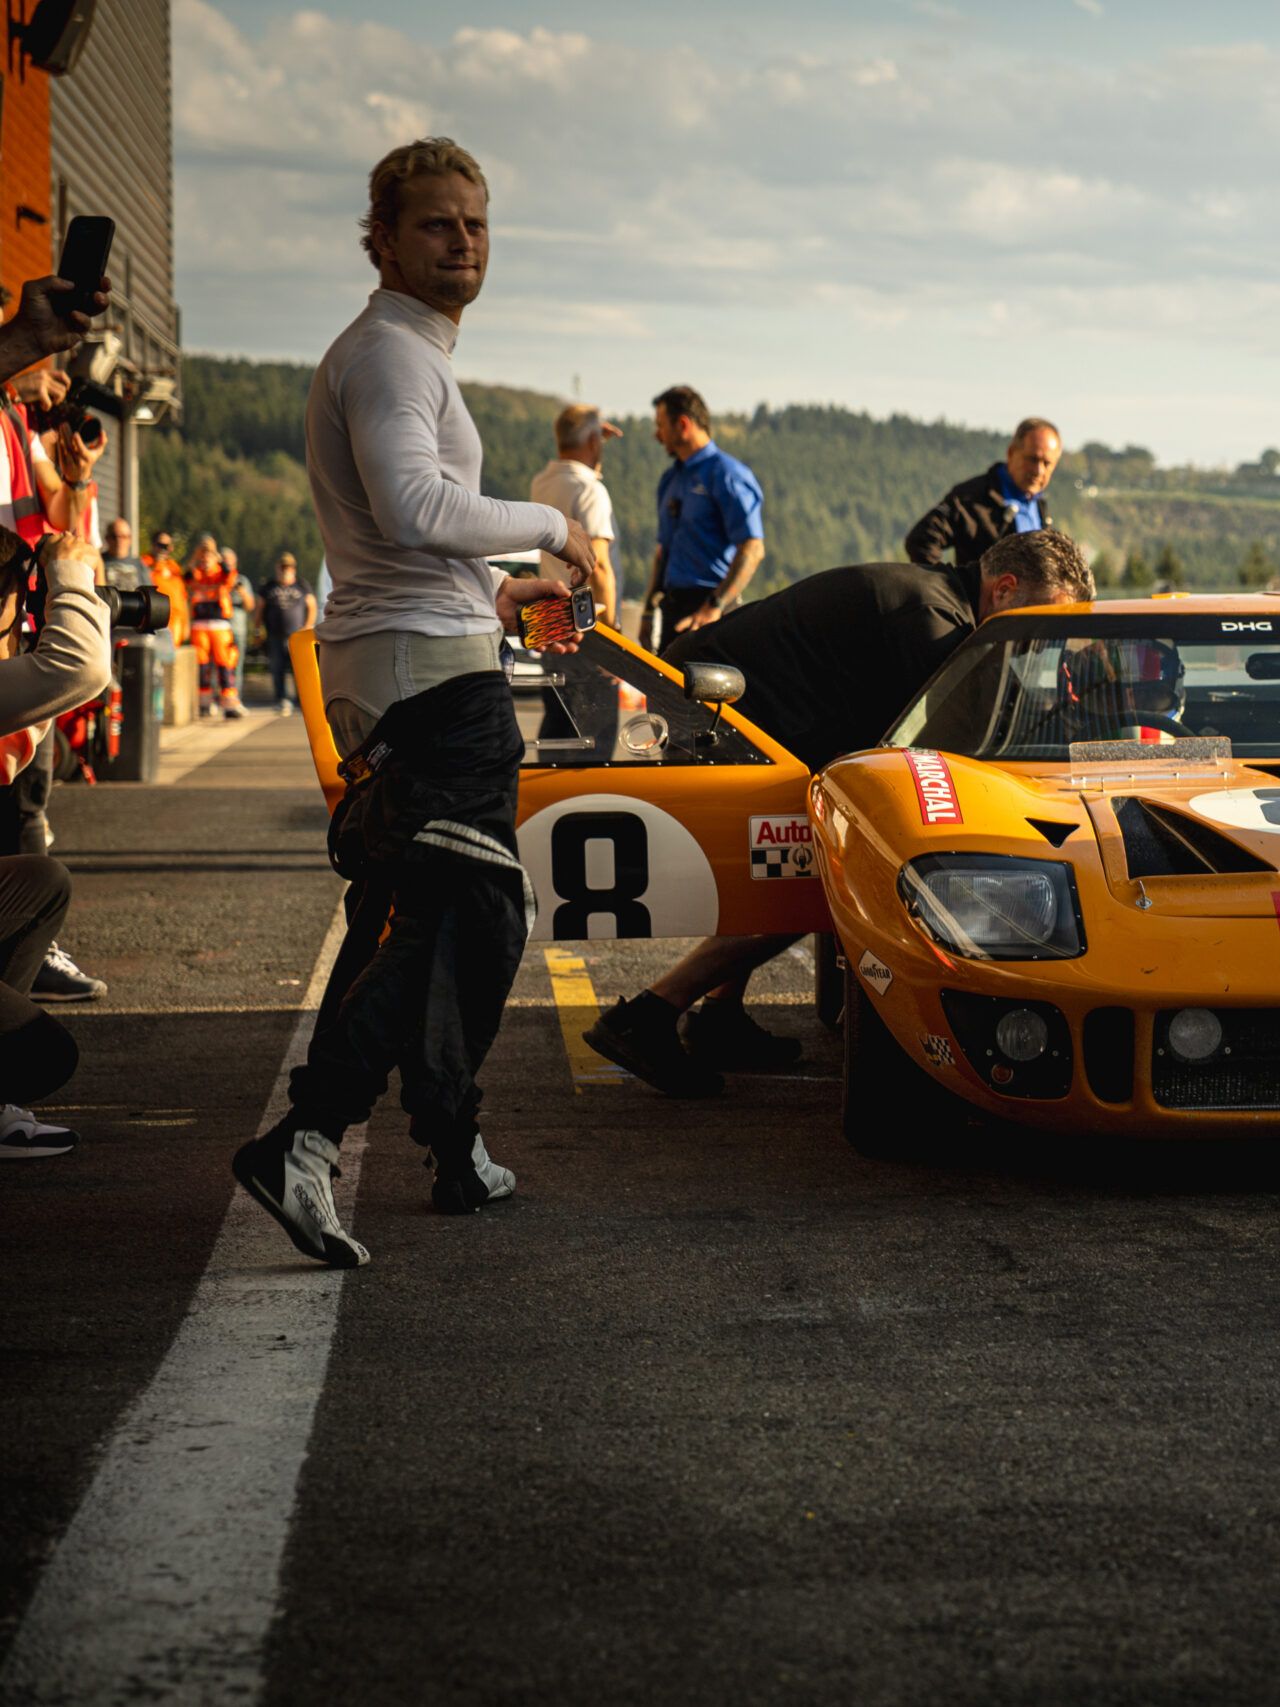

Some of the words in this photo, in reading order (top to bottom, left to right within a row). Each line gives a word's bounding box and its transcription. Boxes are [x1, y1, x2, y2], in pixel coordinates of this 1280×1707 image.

[1221, 621, 1273, 632] DHG
[909, 752, 957, 822] MARCHAL
[756, 820, 812, 845] Auto
[551, 811, 652, 941] 8
